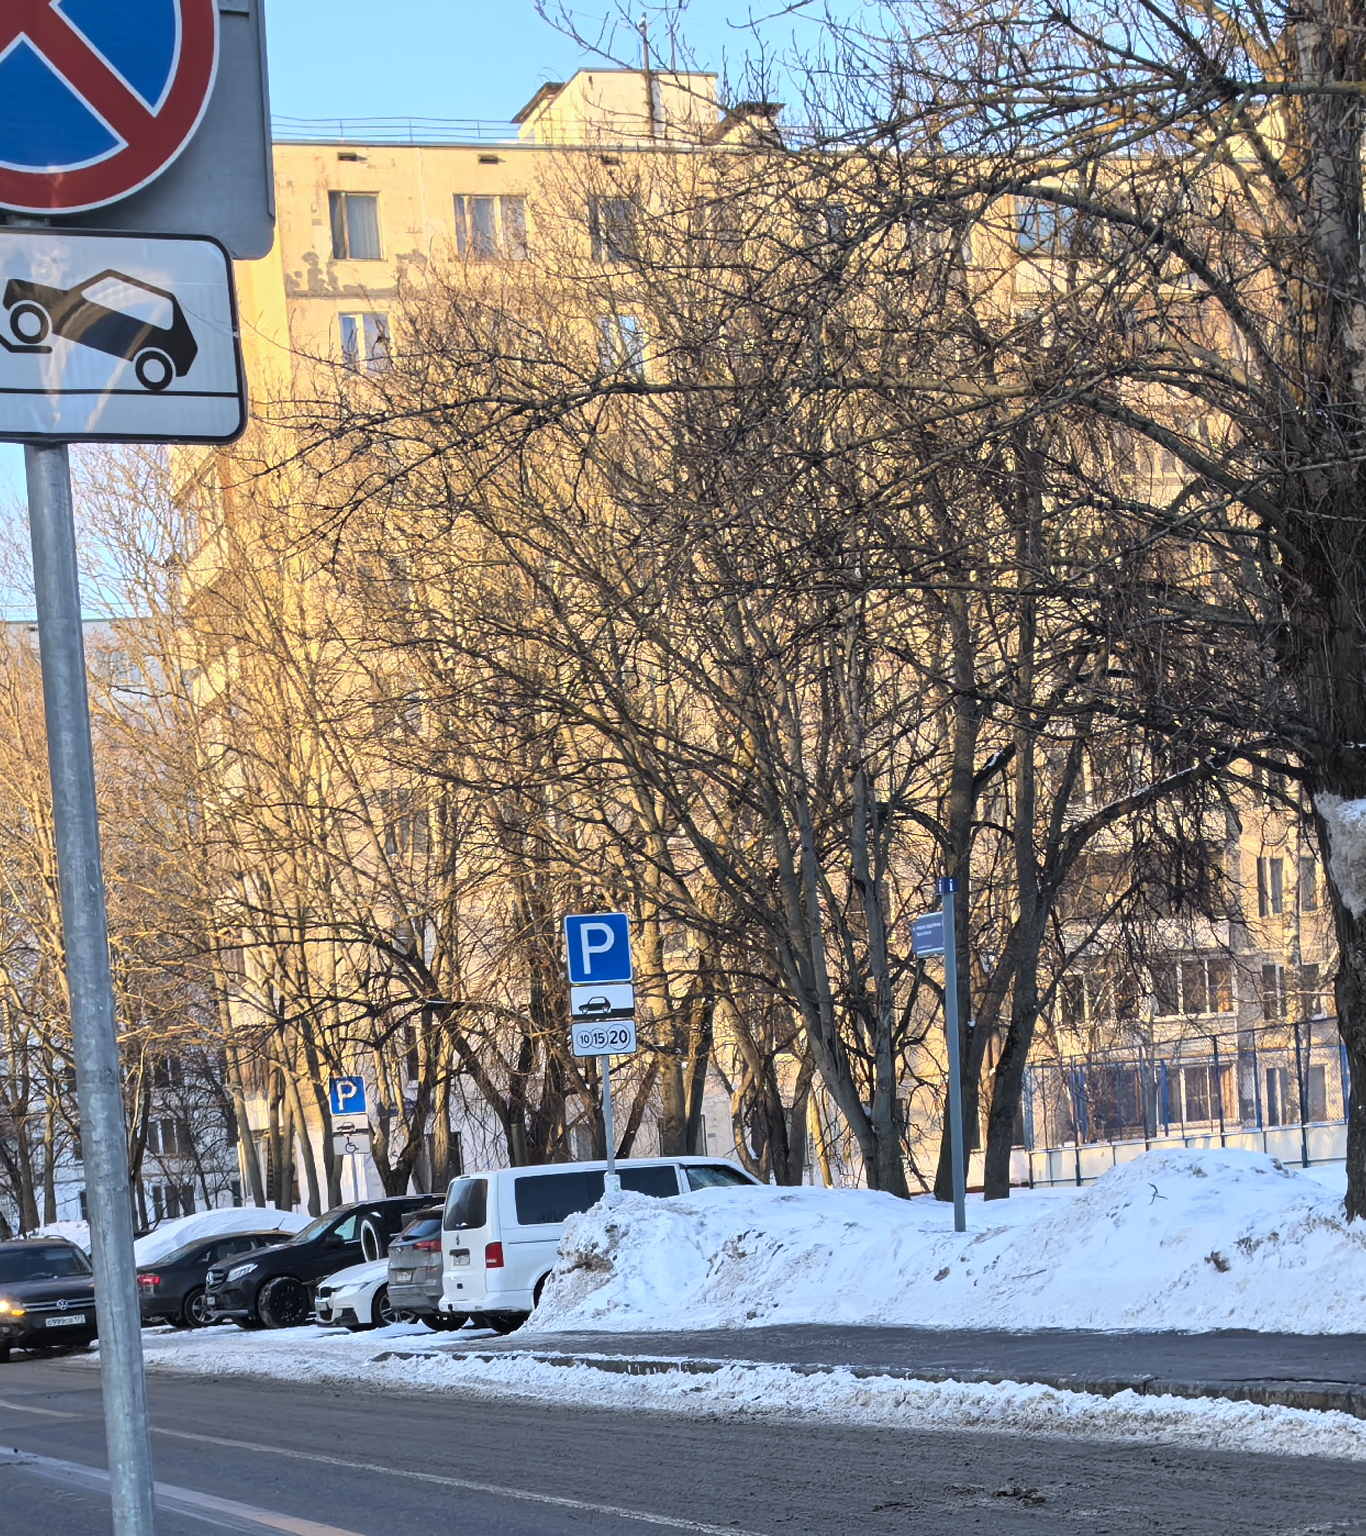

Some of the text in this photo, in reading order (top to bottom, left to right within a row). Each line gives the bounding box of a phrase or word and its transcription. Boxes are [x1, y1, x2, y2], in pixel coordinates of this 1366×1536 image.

[580, 922, 615, 975] P
[580, 1029, 628, 1045] 10 15 20
[336, 1080, 357, 1111] P
